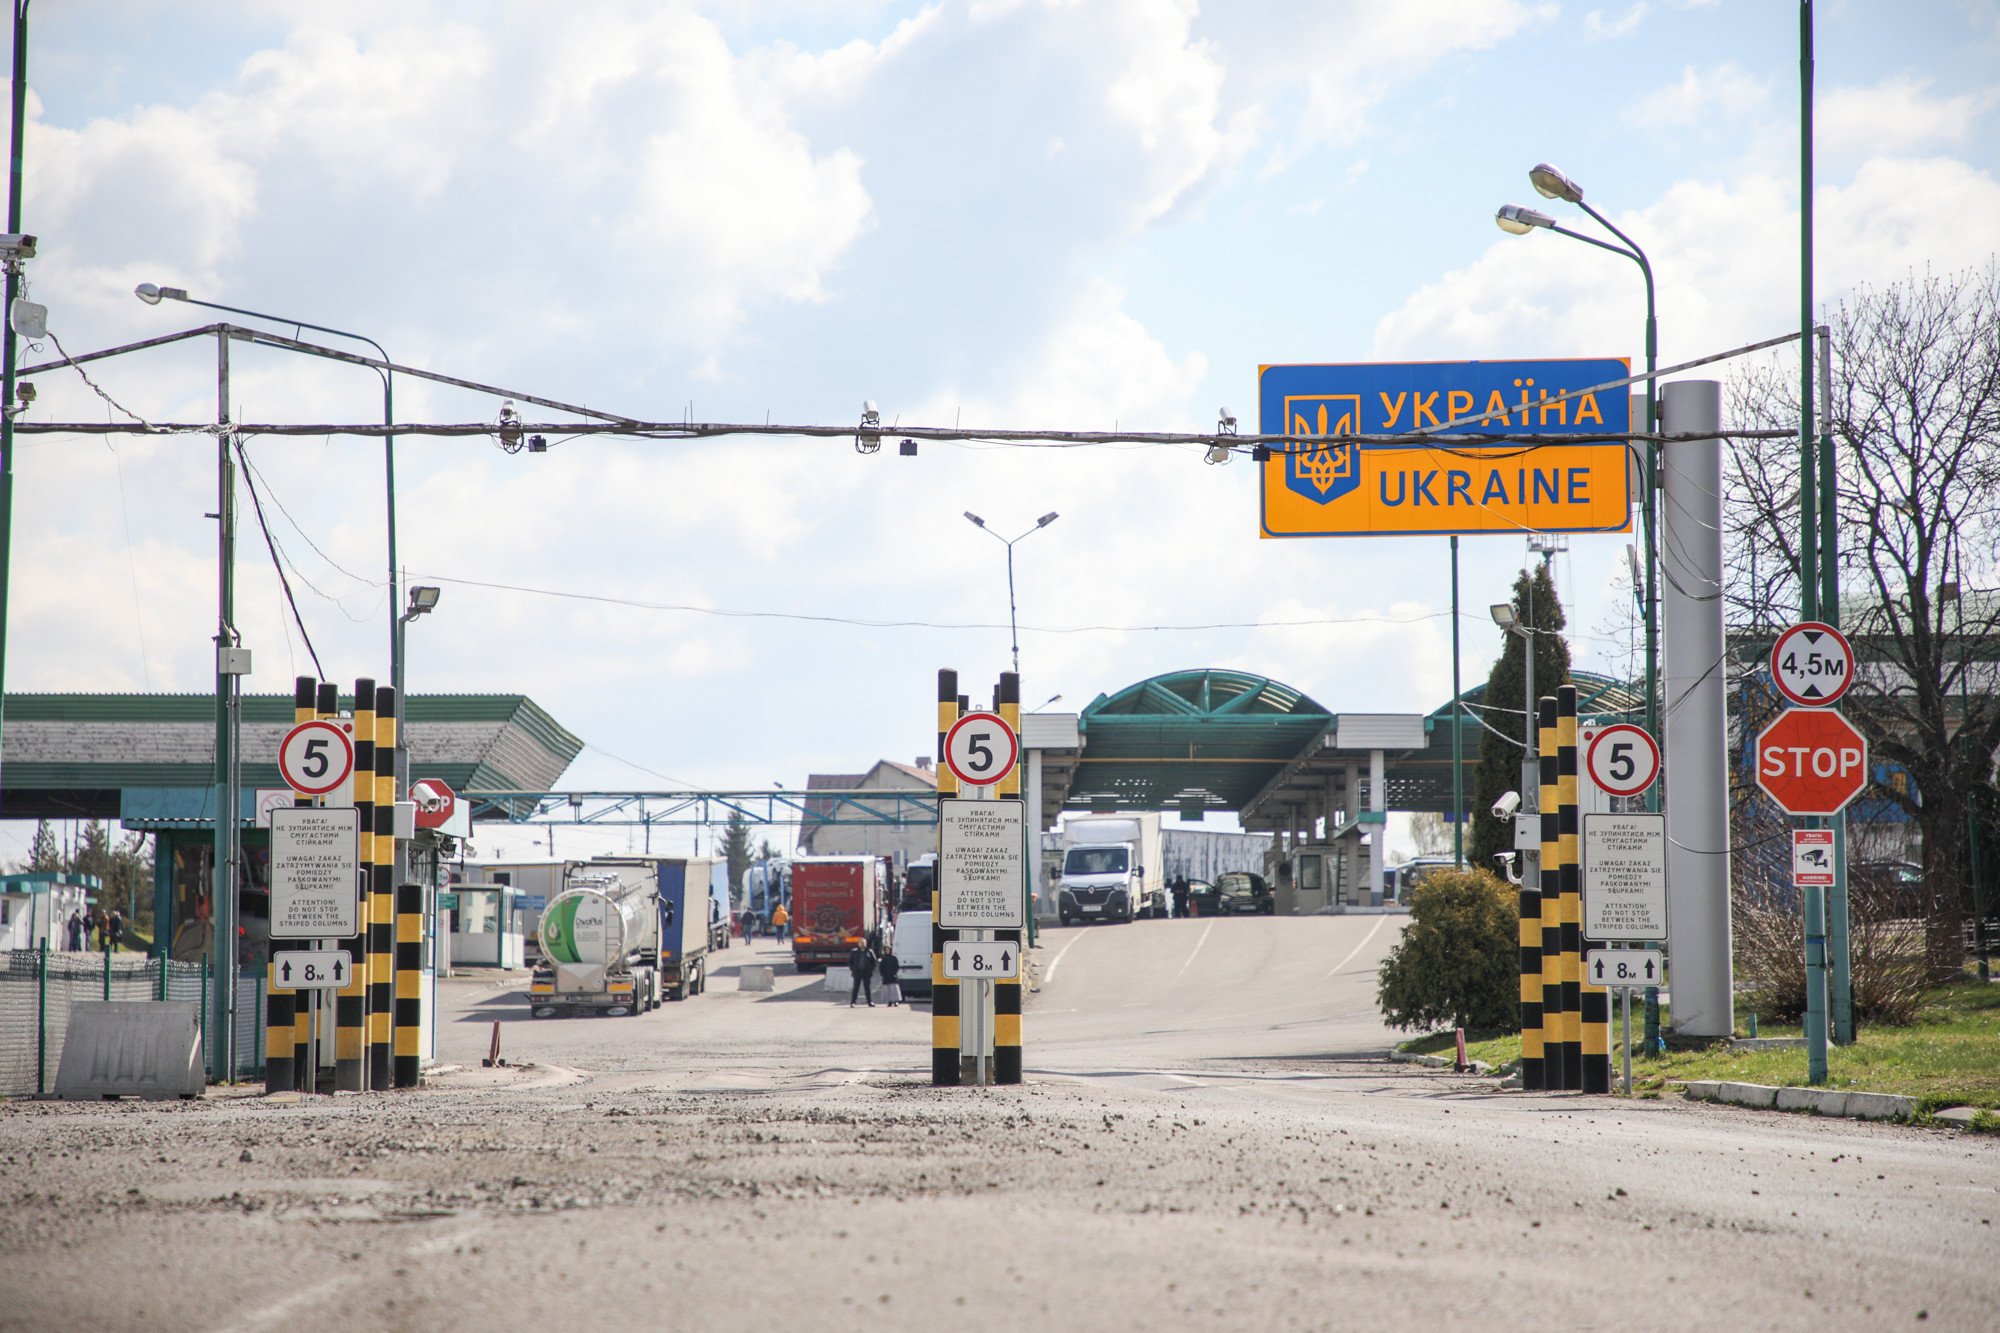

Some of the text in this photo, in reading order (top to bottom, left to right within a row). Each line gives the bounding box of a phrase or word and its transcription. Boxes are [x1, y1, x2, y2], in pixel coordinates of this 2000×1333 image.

[1380, 378, 1604, 428] УКРАЇНА
[1380, 467, 1590, 506] UKRAINE
[302, 740, 328, 778] 5
[968, 733, 993, 772] 5
[1609, 744, 1636, 780] 5
[1762, 746, 1861, 778] STOP
